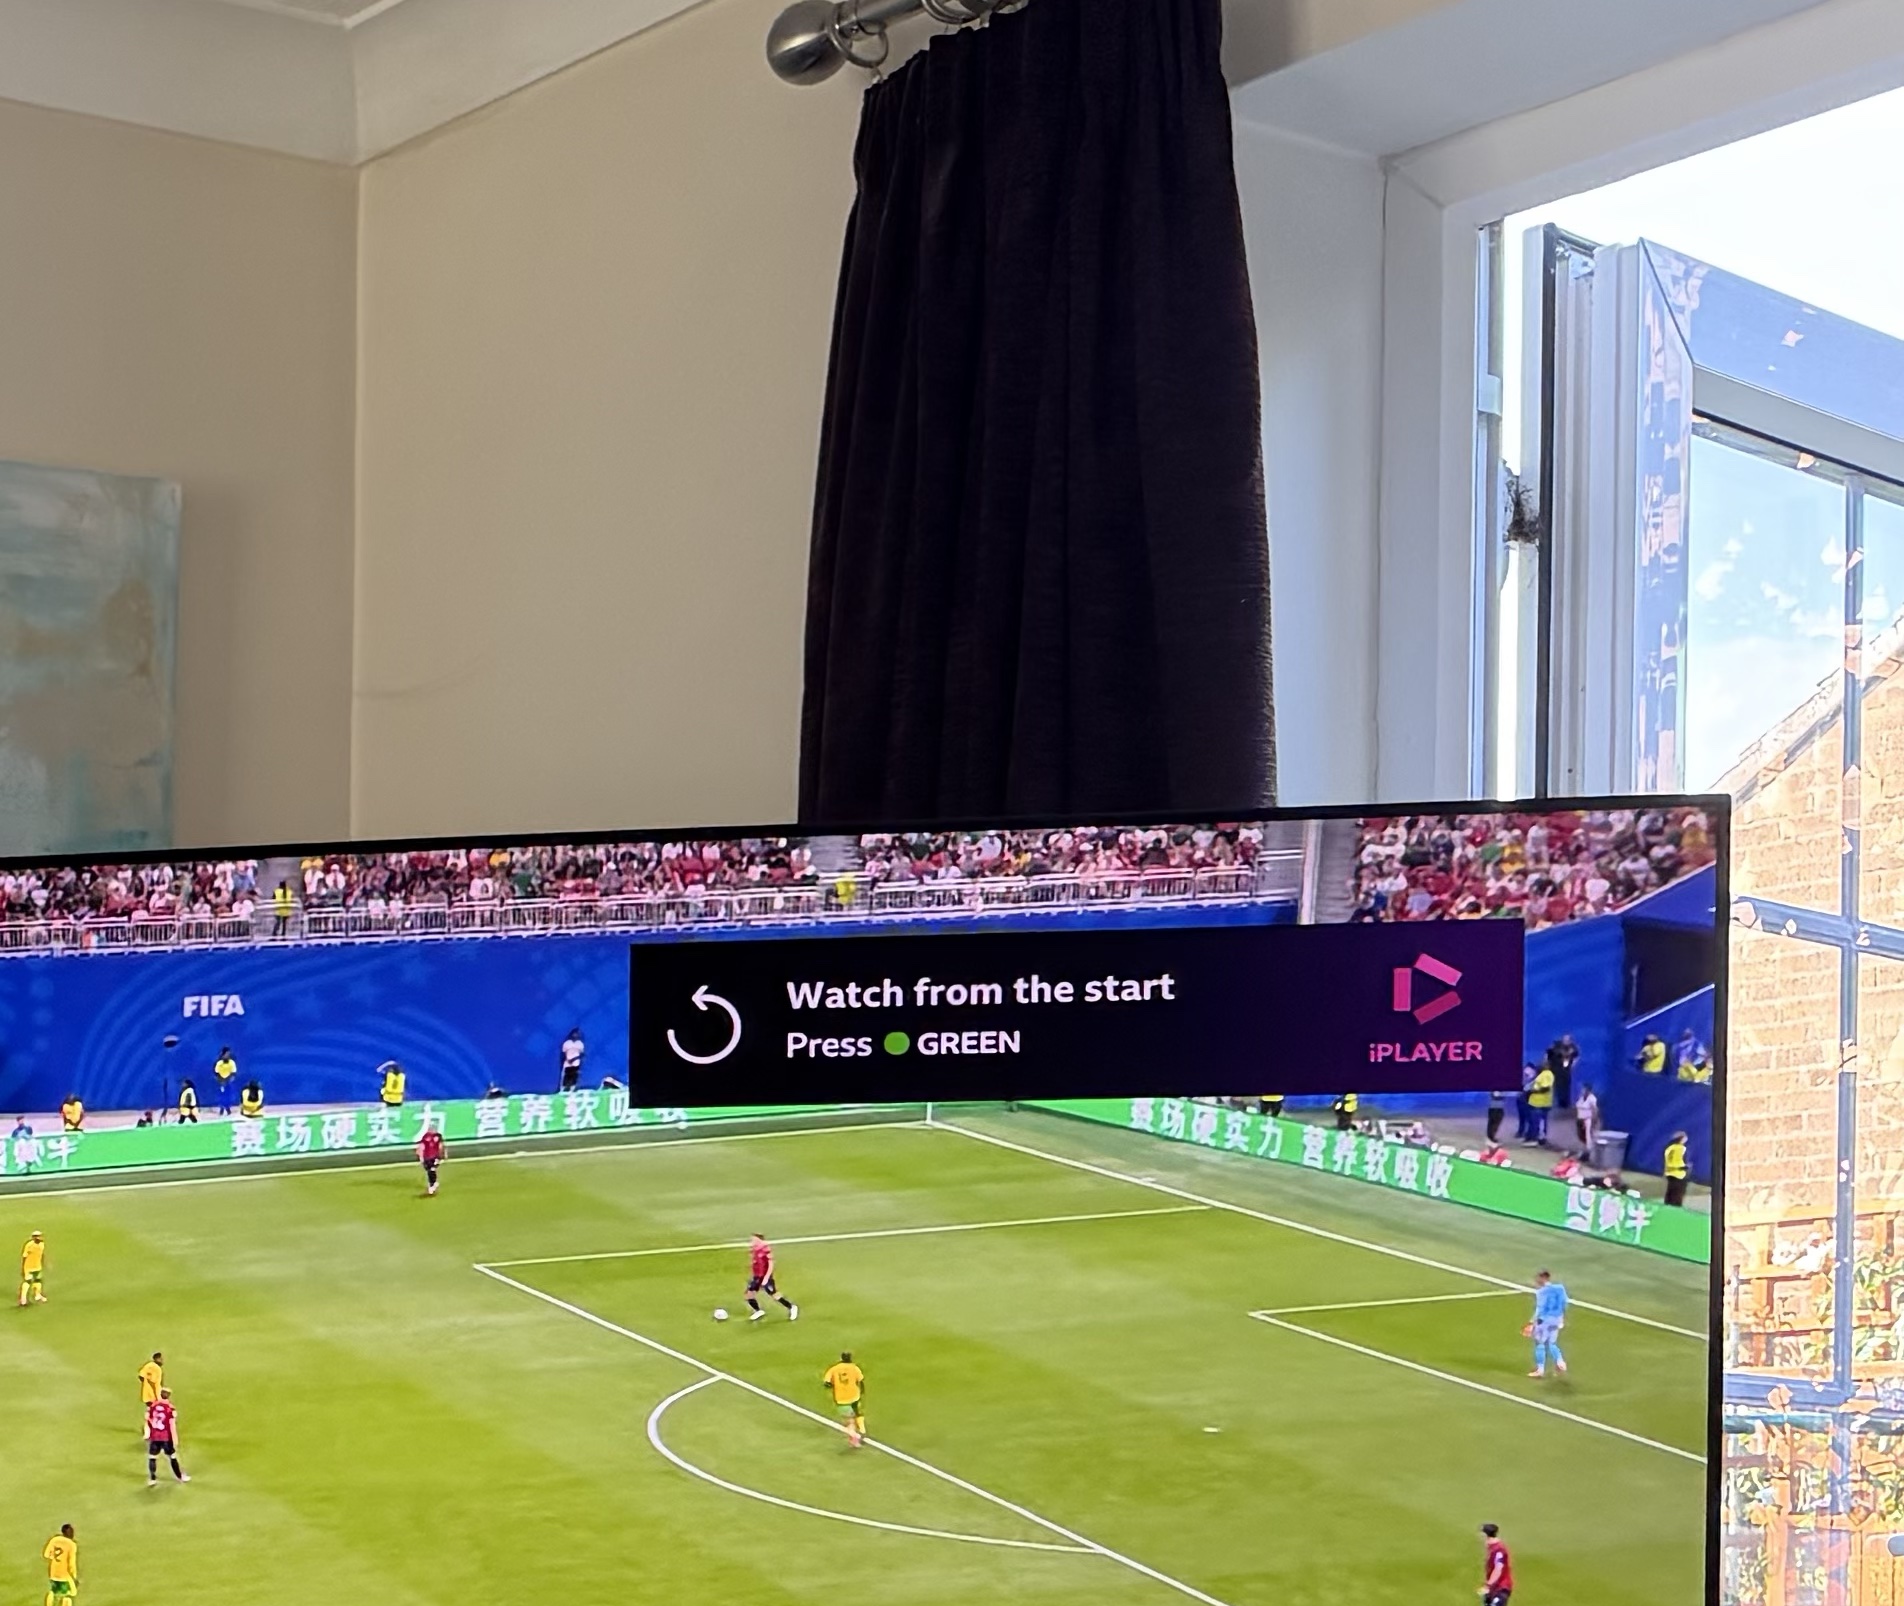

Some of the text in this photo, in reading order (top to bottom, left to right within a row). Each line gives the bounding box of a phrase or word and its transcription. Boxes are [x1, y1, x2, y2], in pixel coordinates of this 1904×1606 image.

[183, 994, 245, 1018] FIFA
[786, 973, 1176, 1010] Watch from the start
[786, 1030, 1022, 1059] Press GREEN
[1369, 1041, 1483, 1063] iPLAYER
[474, 1088, 688, 1138] 营养软吸
